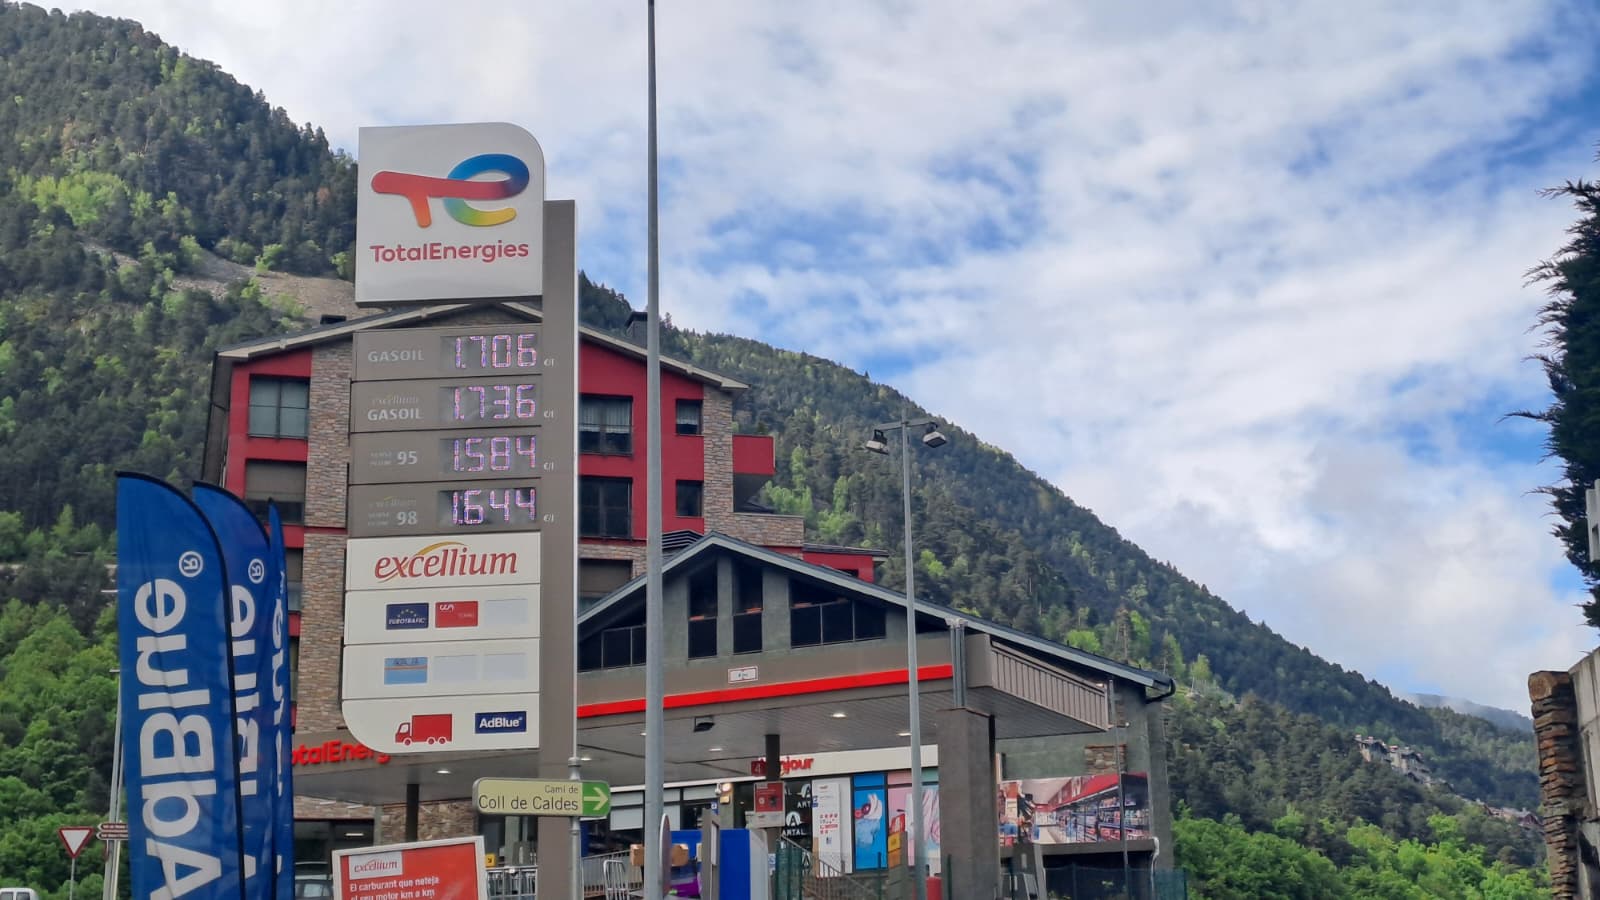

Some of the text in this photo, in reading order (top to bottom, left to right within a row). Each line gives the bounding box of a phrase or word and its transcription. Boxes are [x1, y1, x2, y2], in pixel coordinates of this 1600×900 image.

[369, 240, 529, 262] TotalEnergies
[367, 349, 424, 362] GASOIL
[455, 334, 537, 368] 1.706
[367, 407, 423, 421] GASOIL
[454, 384, 536, 419] 1.736
[397, 450, 418, 465] 95
[396, 511, 418, 525] 98
[374, 546, 518, 581] excellium
[568, 785, 578, 794] de
[478, 795, 579, 811] Coll de Caldes
[349, 876, 440, 892] El carburant que neteja
